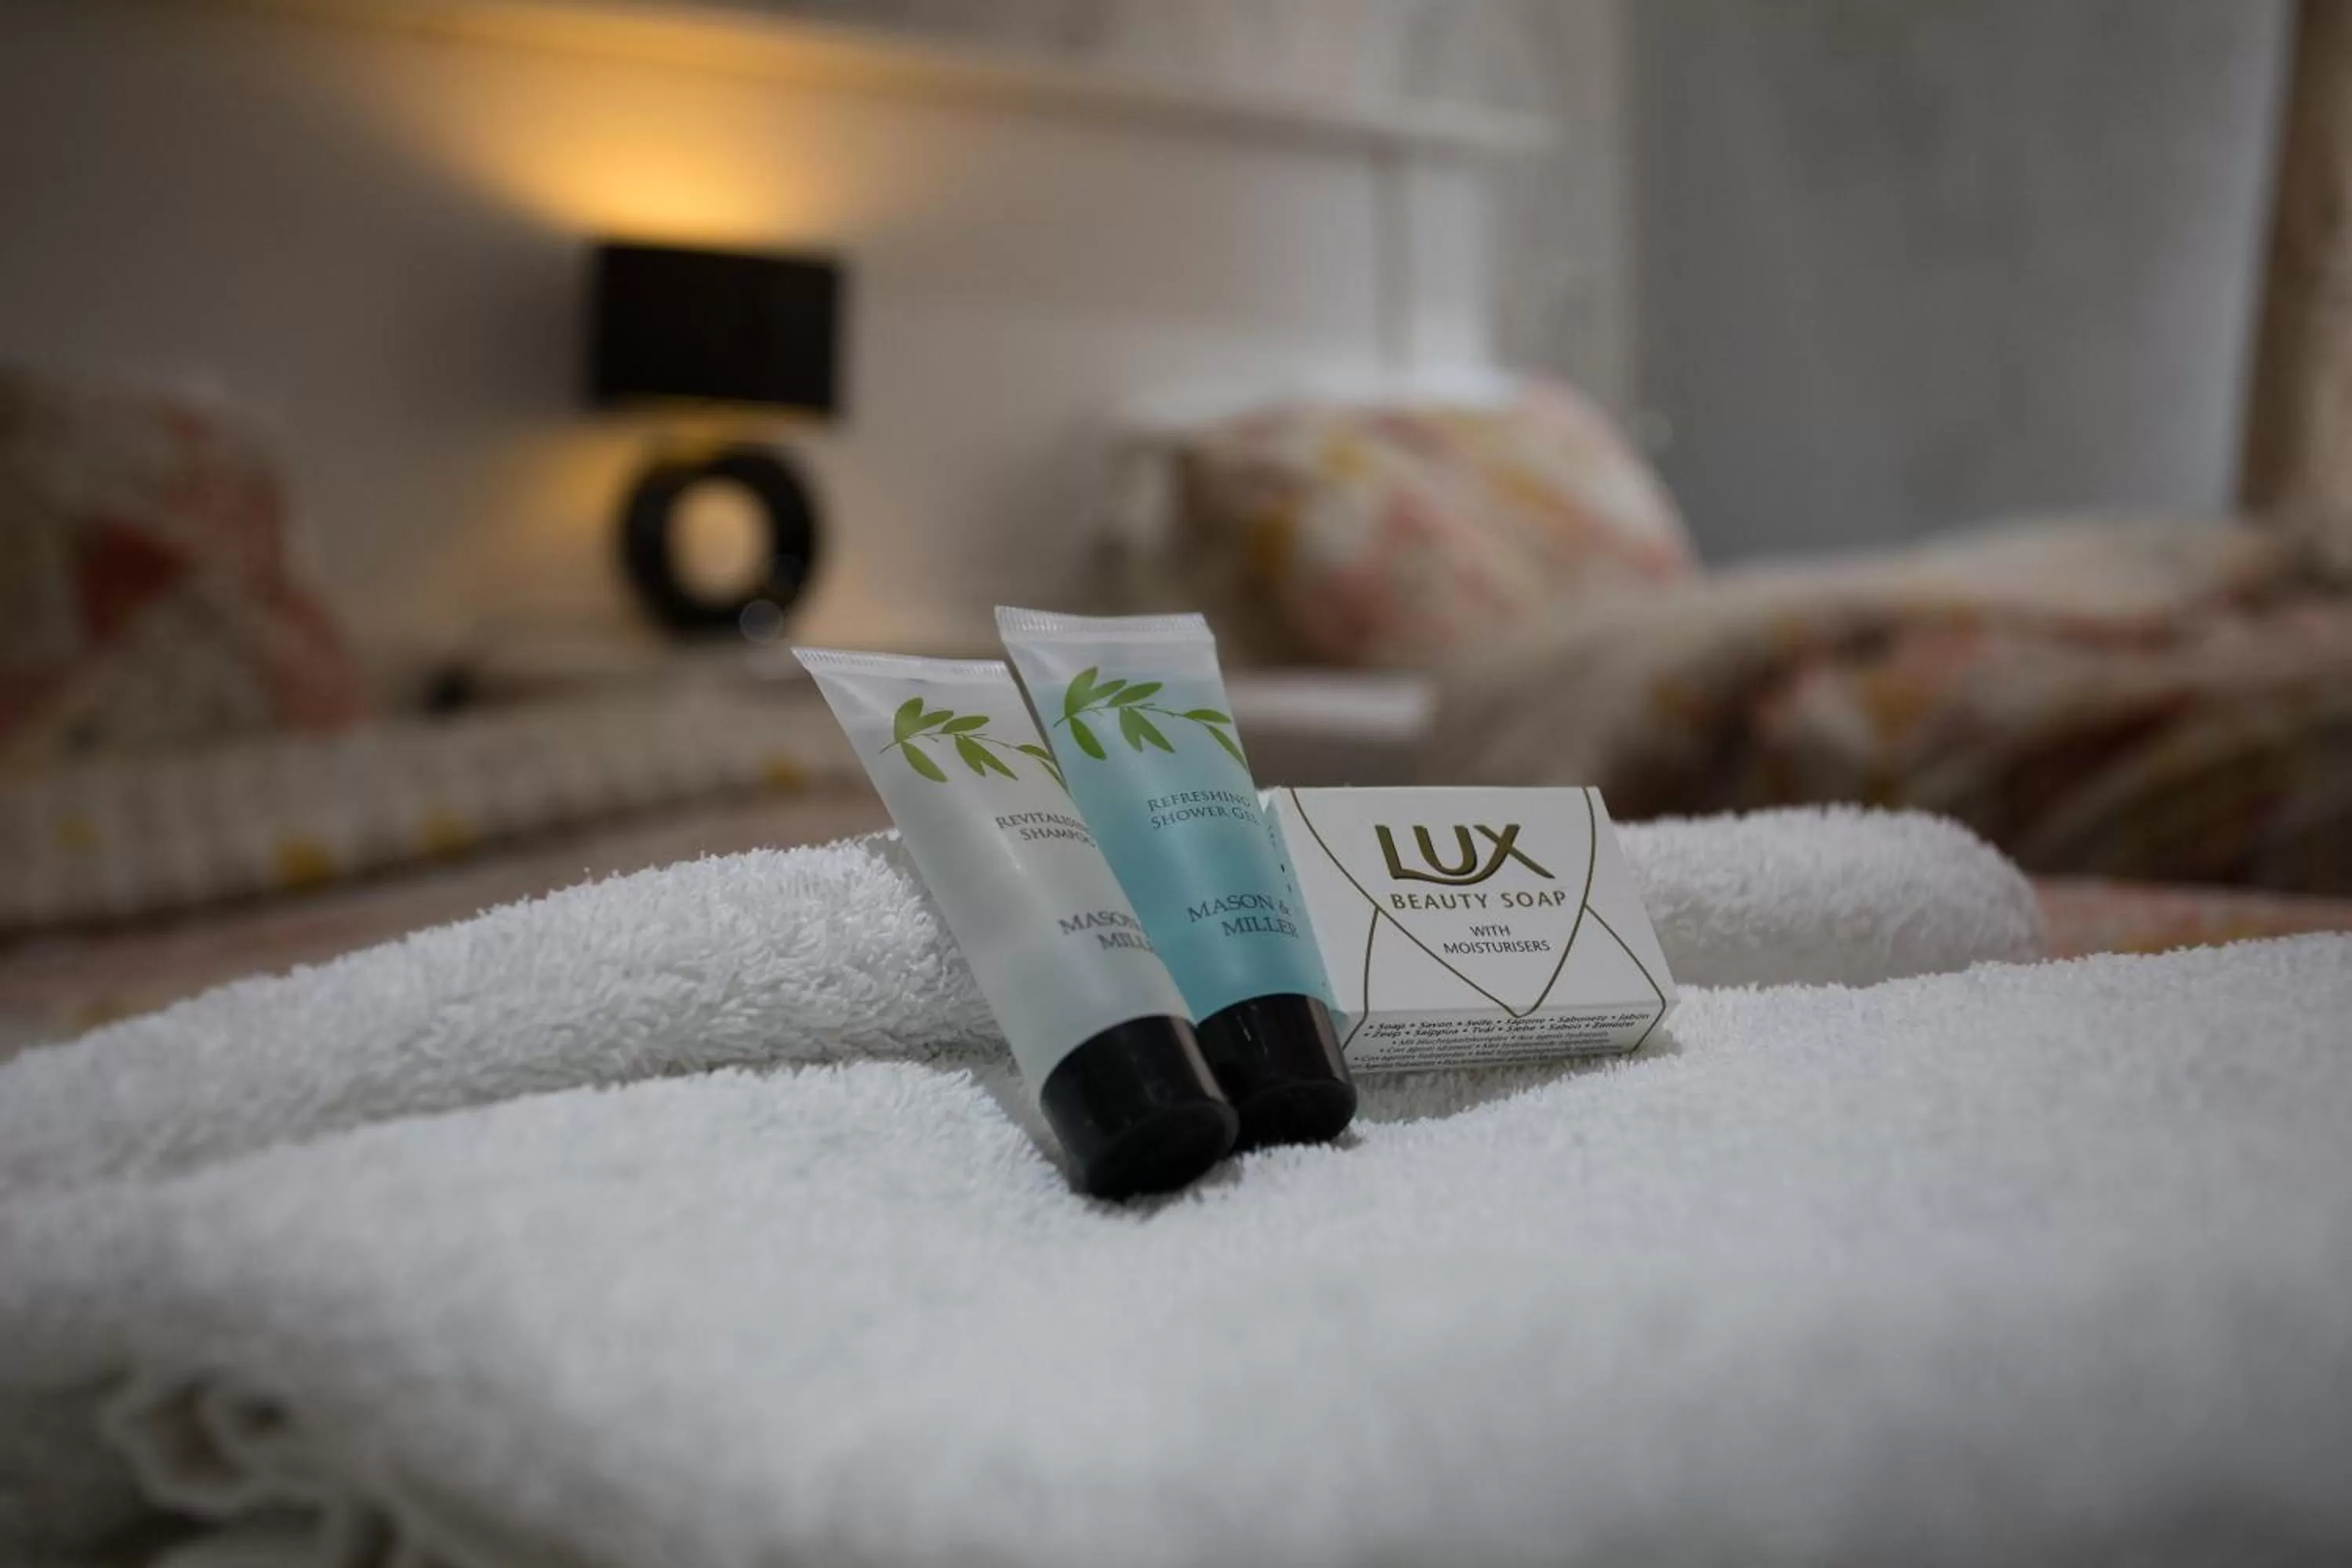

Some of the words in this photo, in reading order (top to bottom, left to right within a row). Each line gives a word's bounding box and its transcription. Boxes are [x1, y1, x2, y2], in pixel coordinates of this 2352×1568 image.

[1147, 789, 1252, 812] REFRESHING
[1150, 804, 1231, 829] SHOWER
[1375, 824, 1555, 884] LUX
[1187, 893, 1275, 923] MASON
[1391, 892, 1488, 910] BEAUTY
[1501, 890, 1567, 908] SOAP
[1220, 916, 1300, 939] MILLER
[1468, 924, 1512, 938] WITH
[1443, 940, 1552, 954] MOISTURISERS
